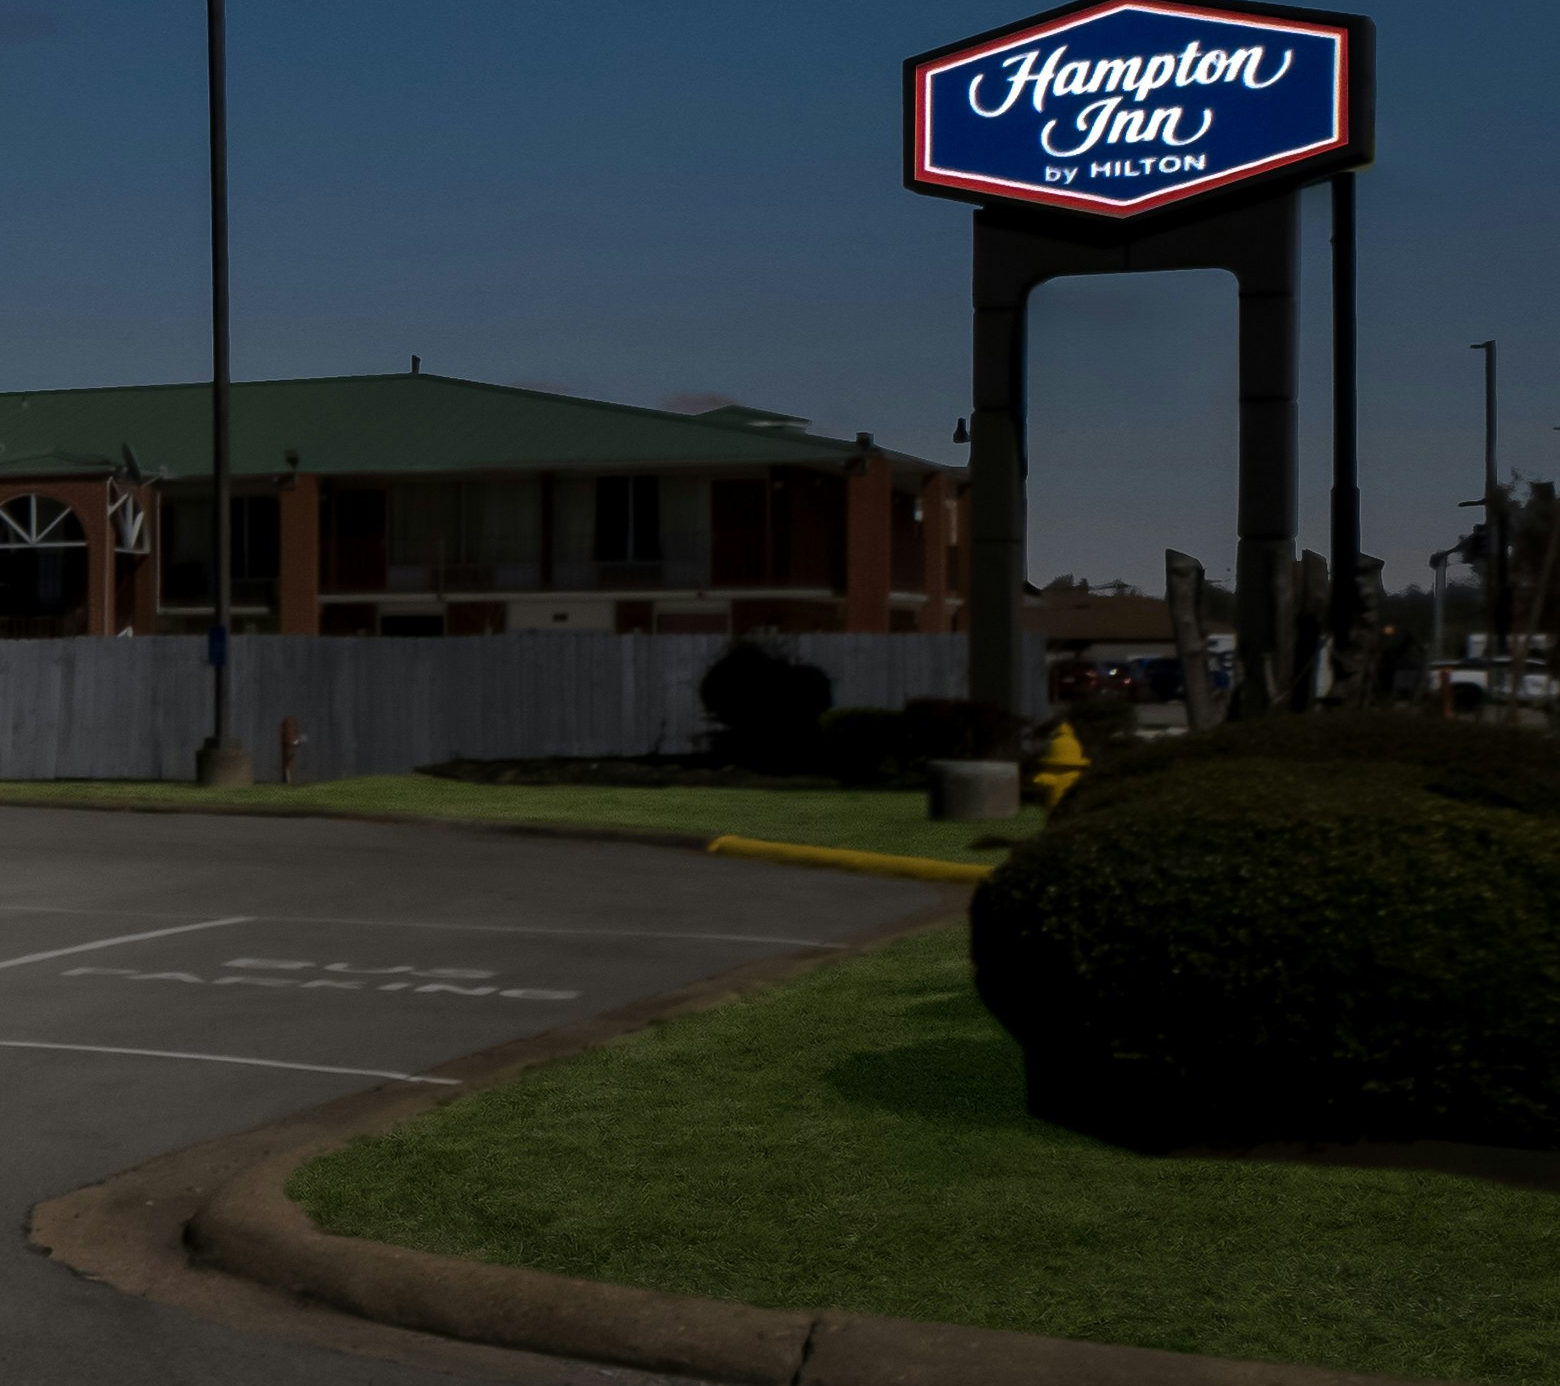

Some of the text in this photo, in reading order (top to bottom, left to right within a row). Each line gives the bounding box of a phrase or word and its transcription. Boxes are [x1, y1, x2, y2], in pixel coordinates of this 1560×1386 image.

[968, 40, 1293, 118] Hampton
[1040, 97, 1214, 158] Inn
[1044, 154, 1207, 184] by HILTON
[59, 966, 581, 1000] PARKING
[222, 957, 497, 979] BUS
